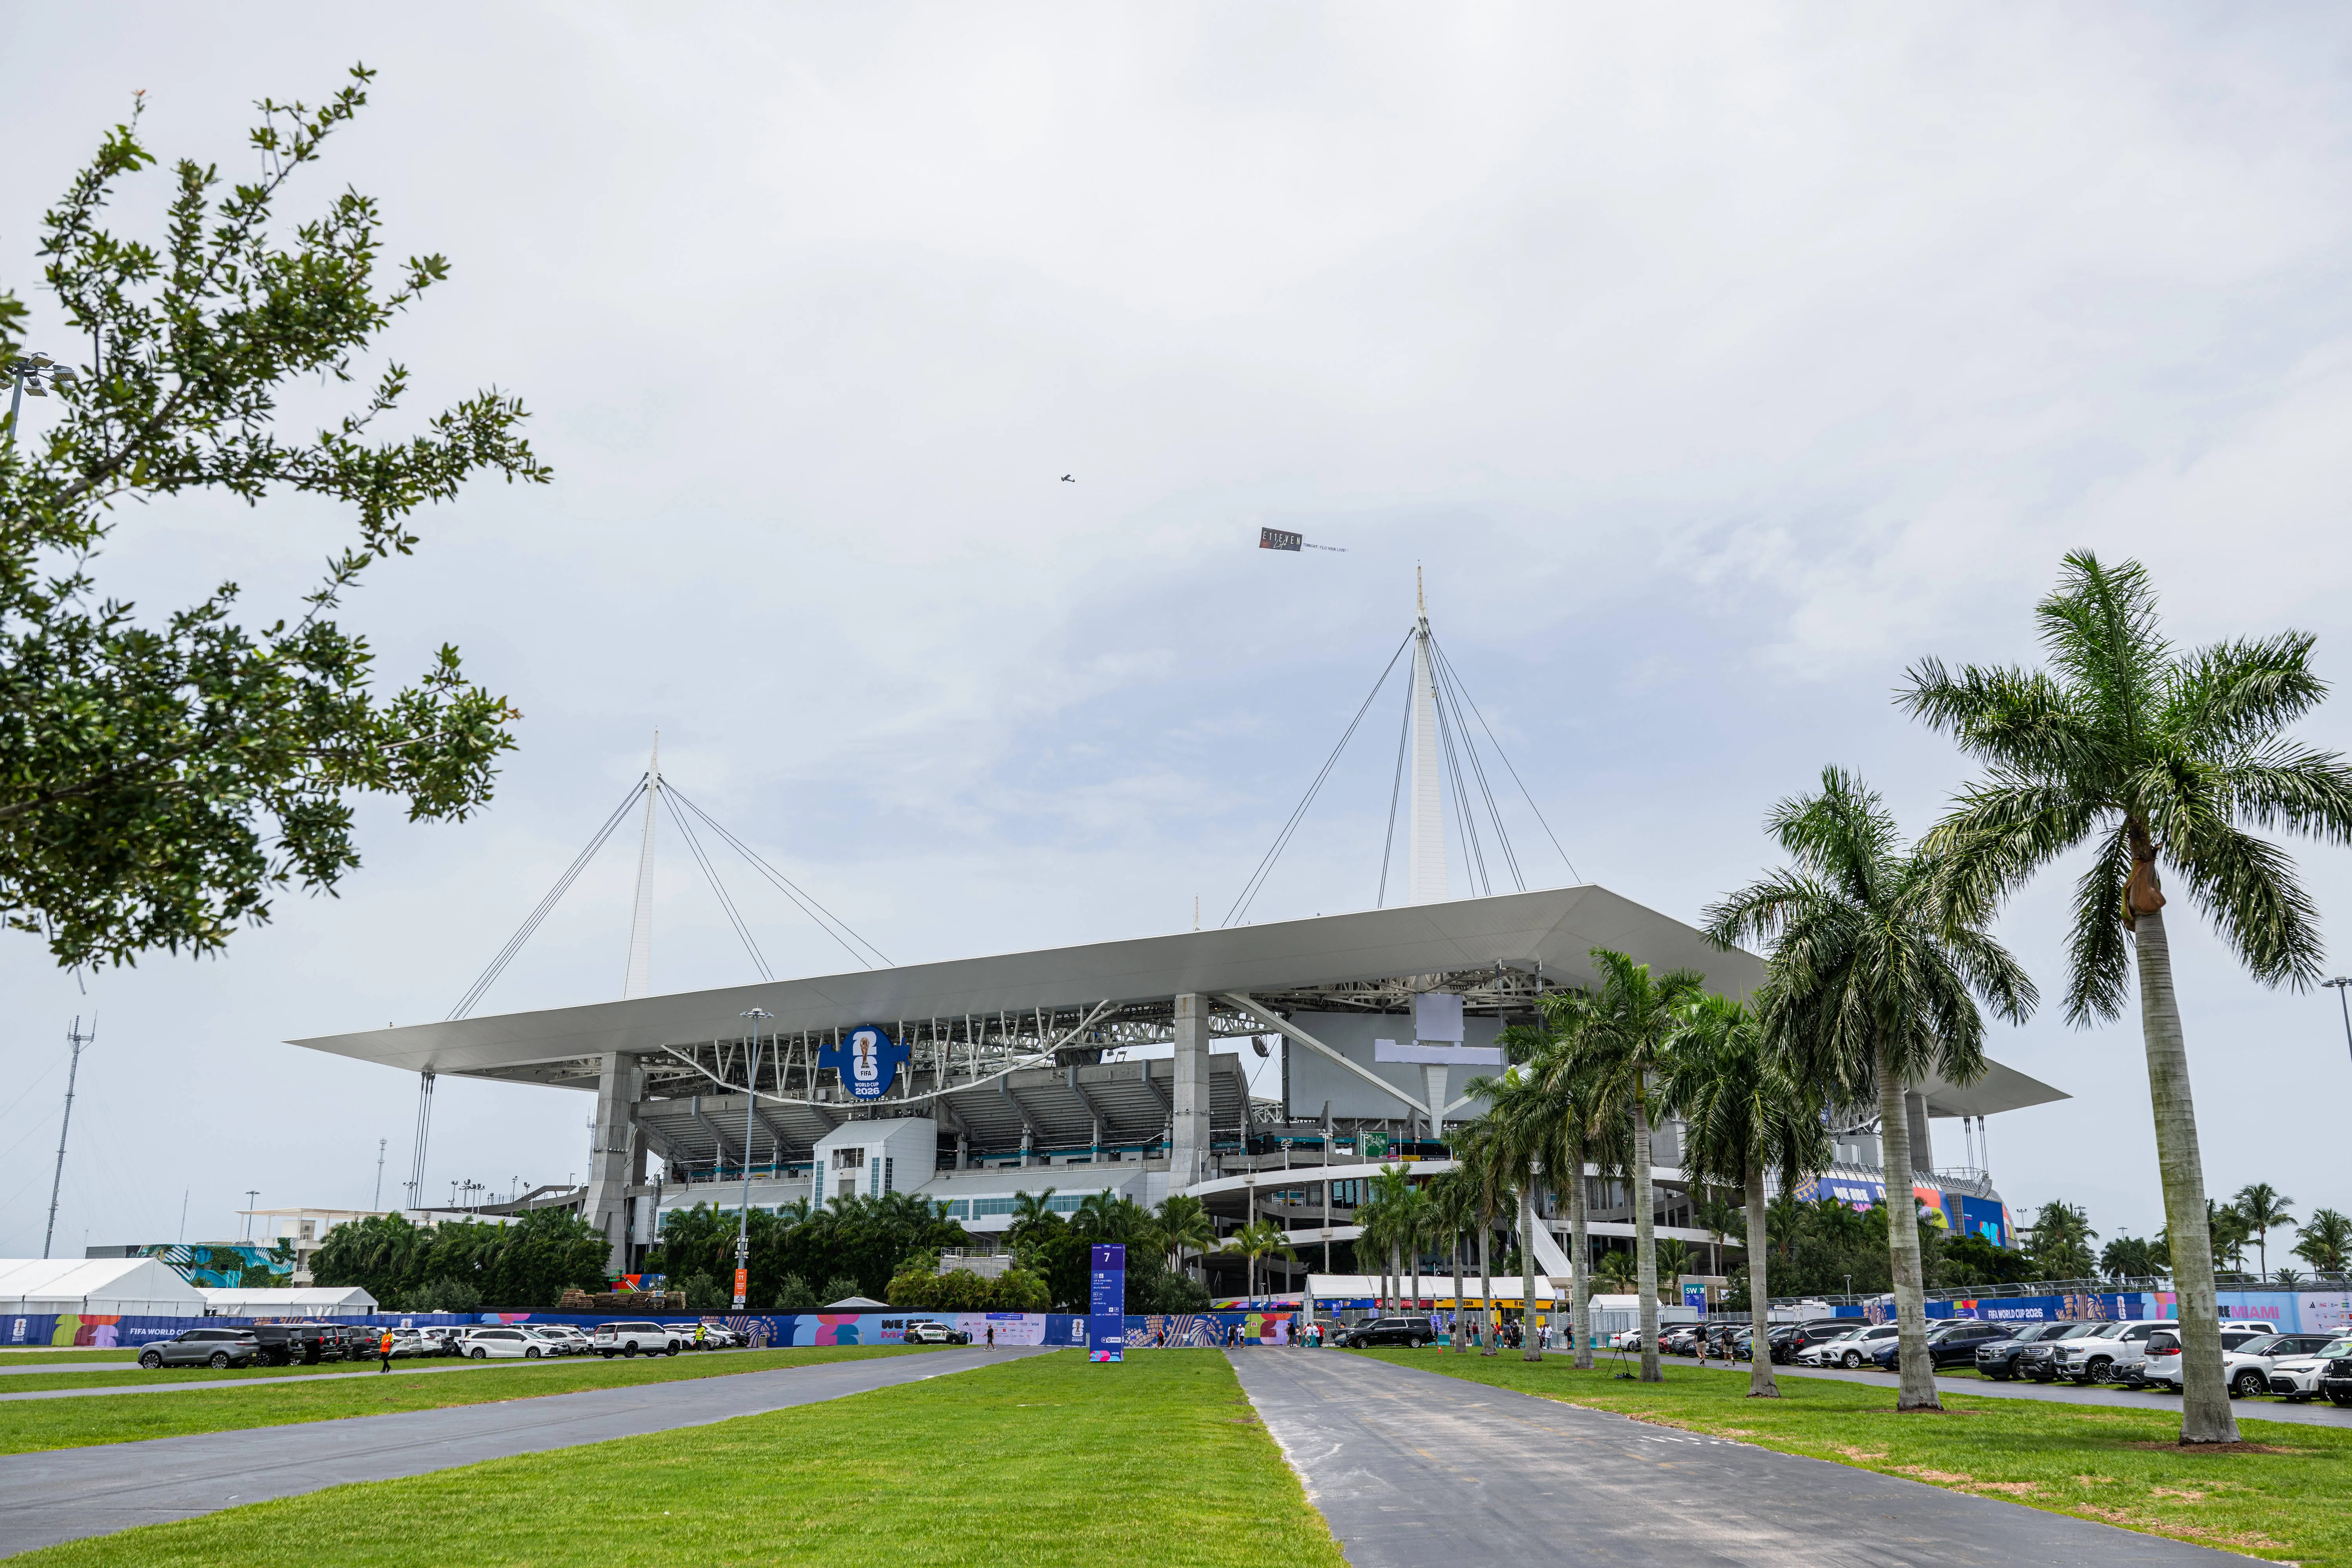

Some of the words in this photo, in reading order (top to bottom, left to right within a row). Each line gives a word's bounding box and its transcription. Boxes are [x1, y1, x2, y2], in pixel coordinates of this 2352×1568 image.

[1263, 531, 1300, 545] E11EVEN
[1273, 539, 1287, 550] Life
[1833, 1186, 1850, 1200] WE
[1849, 1188, 1870, 1201] ARE
[1104, 1252, 1110, 1262] 7
[1988, 1310, 1998, 1319] FIFA
[1999, 1309, 2015, 1319] WORLD
[2015, 1308, 2025, 1318] CUP
[2025, 1308, 2043, 1318] 2026
[2218, 1305, 2230, 1318] RE
[2231, 1306, 2280, 1319] MIAMI
[882, 1319, 903, 1329] WE
